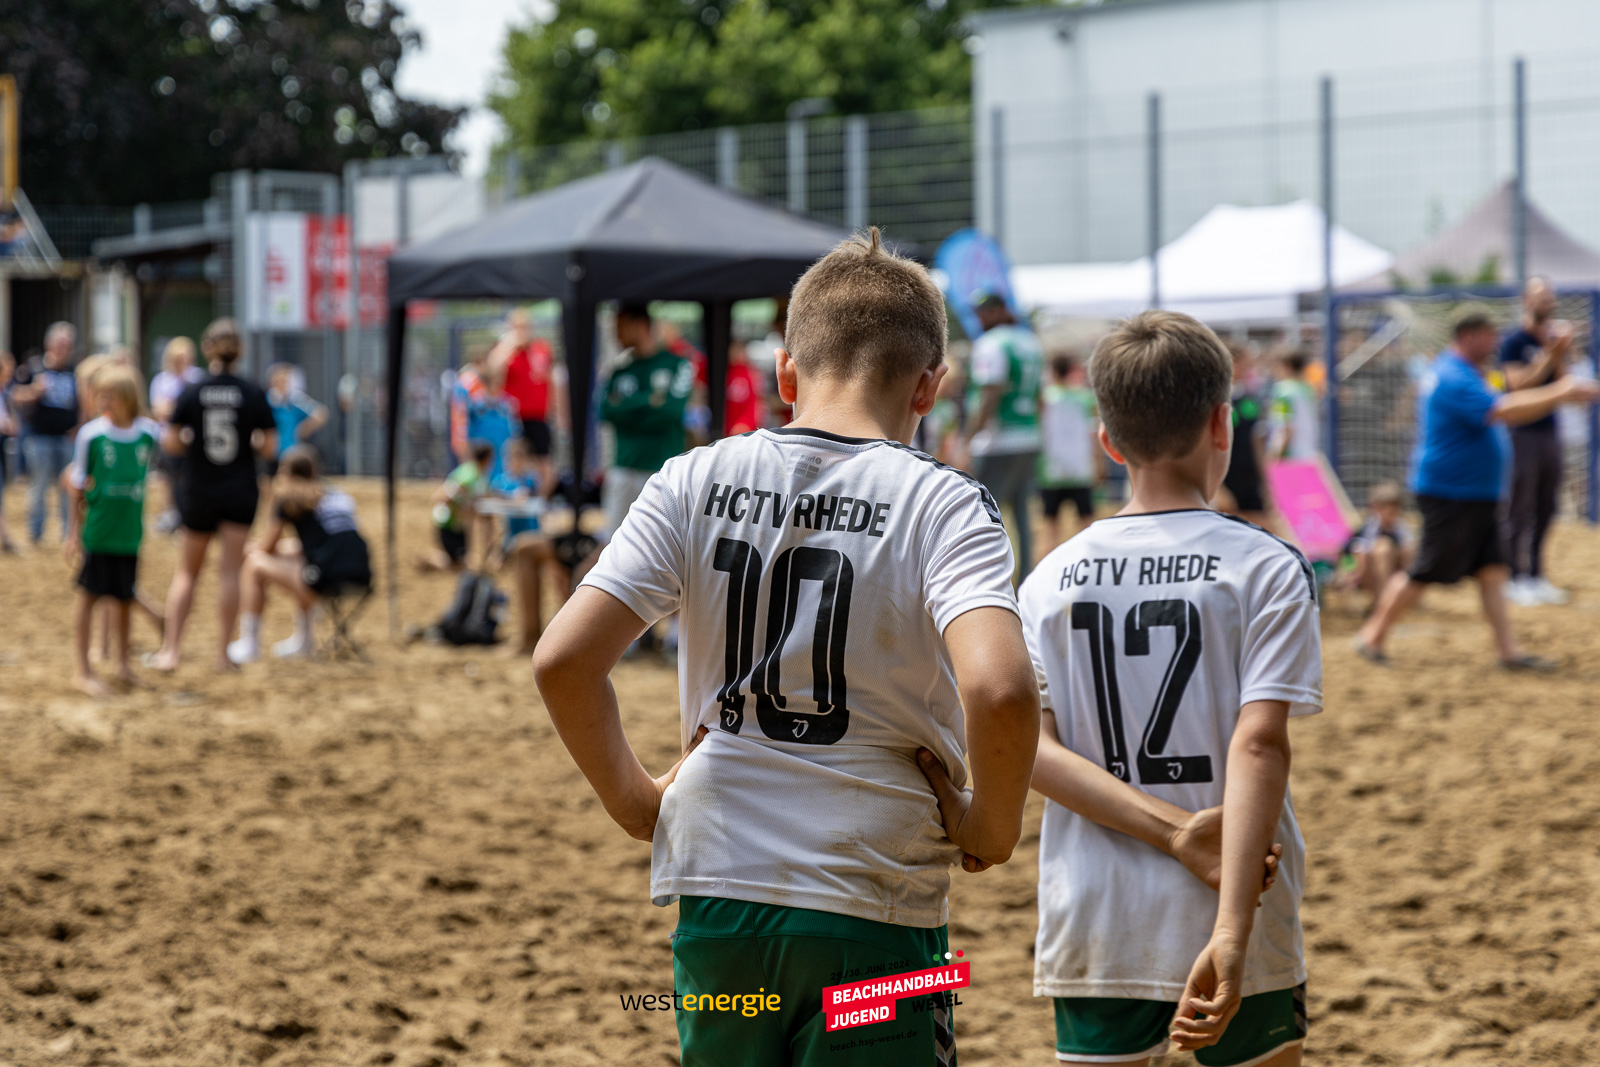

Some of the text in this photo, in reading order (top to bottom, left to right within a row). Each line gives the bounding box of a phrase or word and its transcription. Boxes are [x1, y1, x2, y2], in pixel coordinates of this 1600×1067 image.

[203, 408, 239, 465] 5
[704, 483, 890, 537] HCTV RHEDE
[1059, 554, 1221, 592] HCTV RHEDE
[713, 537, 854, 745] 10
[1071, 599, 1213, 785] 12
